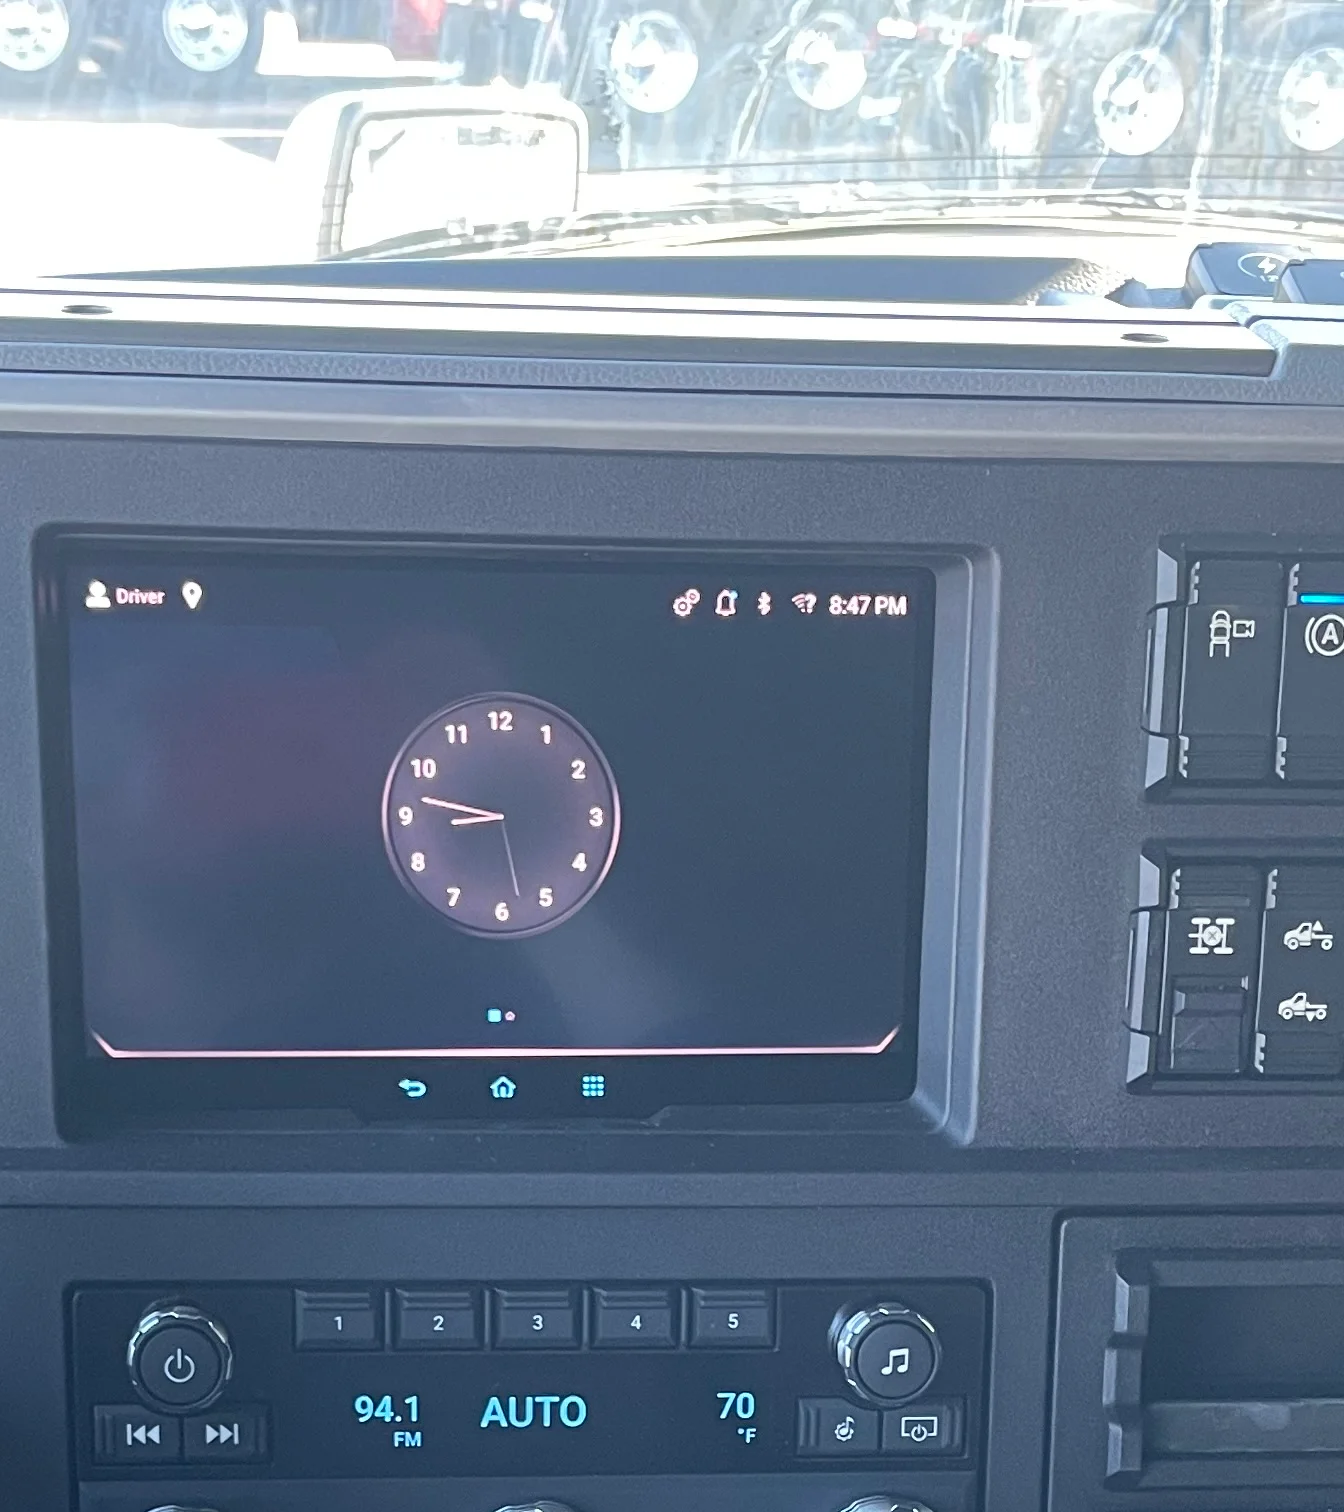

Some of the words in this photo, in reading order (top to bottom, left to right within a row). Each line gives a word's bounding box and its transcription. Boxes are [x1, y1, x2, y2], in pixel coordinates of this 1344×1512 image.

[116, 587, 165, 605] Driver
[828, 594, 871, 615] 8:47
[874, 595, 907, 616] PM
[488, 710, 513, 731] 12
[445, 724, 468, 744] 11
[540, 725, 551, 744] 1
[410, 758, 437, 779] 10
[571, 760, 586, 780] 2
[398, 806, 413, 826] 9
[589, 807, 604, 827] 3
[410, 852, 426, 872] 8
[572, 853, 587, 872] 4
[447, 888, 461, 907] 7
[539, 888, 553, 907] 5
[495, 902, 509, 921] 6
[333, 1316, 343, 1331] 1
[433, 1316, 444, 1331] 2
[532, 1315, 544, 1331] 3
[630, 1315, 642, 1330] 4
[728, 1313, 739, 1329] 5
[354, 1395, 420, 1424] 94.1
[480, 1394, 587, 1428] AUTO
[716, 1391, 755, 1420] 70
[393, 1430, 422, 1448] FM
